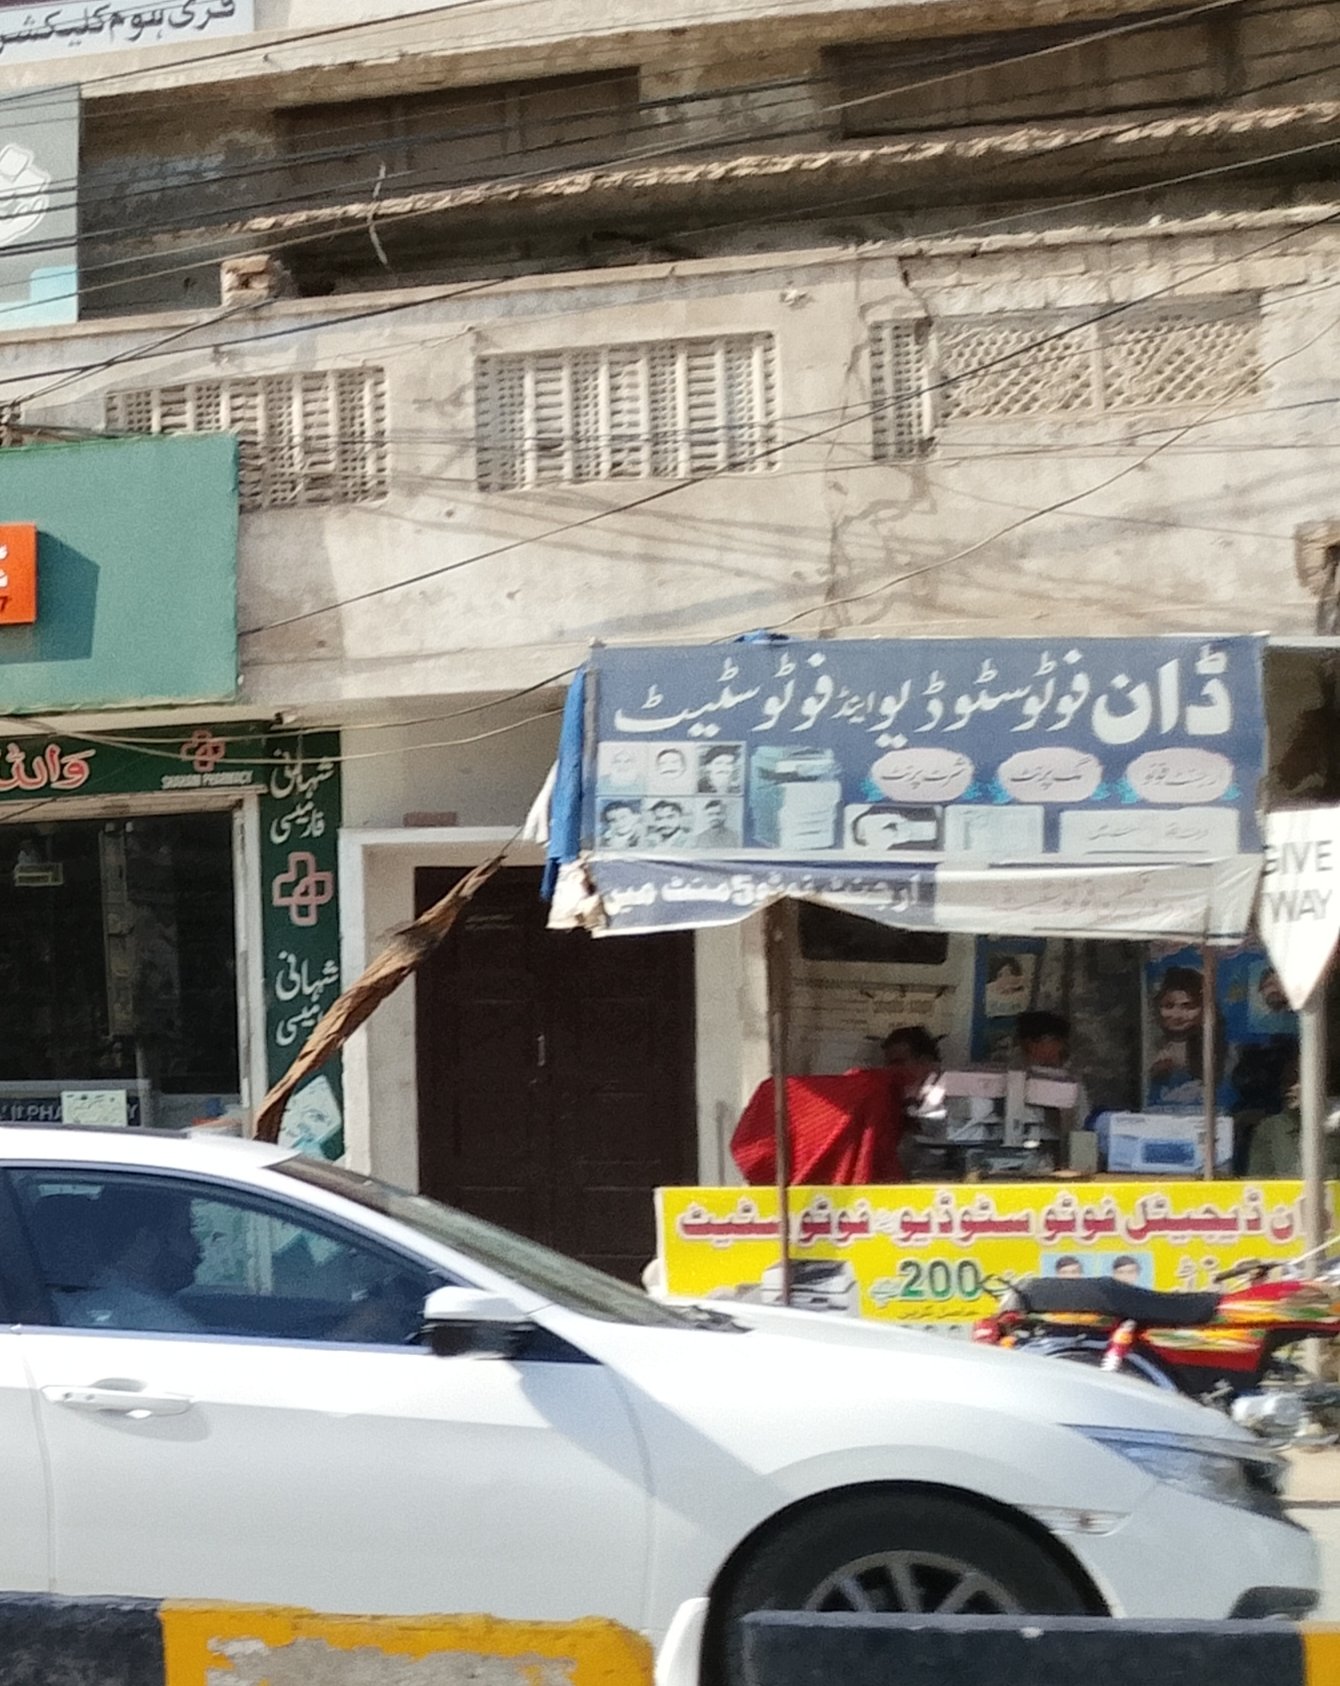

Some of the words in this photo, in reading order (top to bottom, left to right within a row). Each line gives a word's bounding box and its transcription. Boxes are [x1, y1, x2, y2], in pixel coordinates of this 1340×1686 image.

[614, 656, 762, 739] سٹیٹ
[750, 651, 834, 733] فوٹو
[867, 657, 1032, 749] سٹوڈیو
[1009, 648, 1090, 733] فوٹو
[1091, 643, 1233, 745] ڈان
[1262, 839, 1333, 877] GIVE
[603, 881, 657, 917] میں
[660, 875, 731, 902] منٹ
[730, 873, 752, 906] 5
[1263, 888, 1334, 924] WAY
[795, 1194, 872, 1248] فوٹو
[890, 1188, 1036, 1247] سٹوڈیو
[1036, 1190, 1119, 1246] فوٹو
[1123, 1184, 1265, 1245] ڈیجیٹل
[897, 1258, 984, 1302] 200
